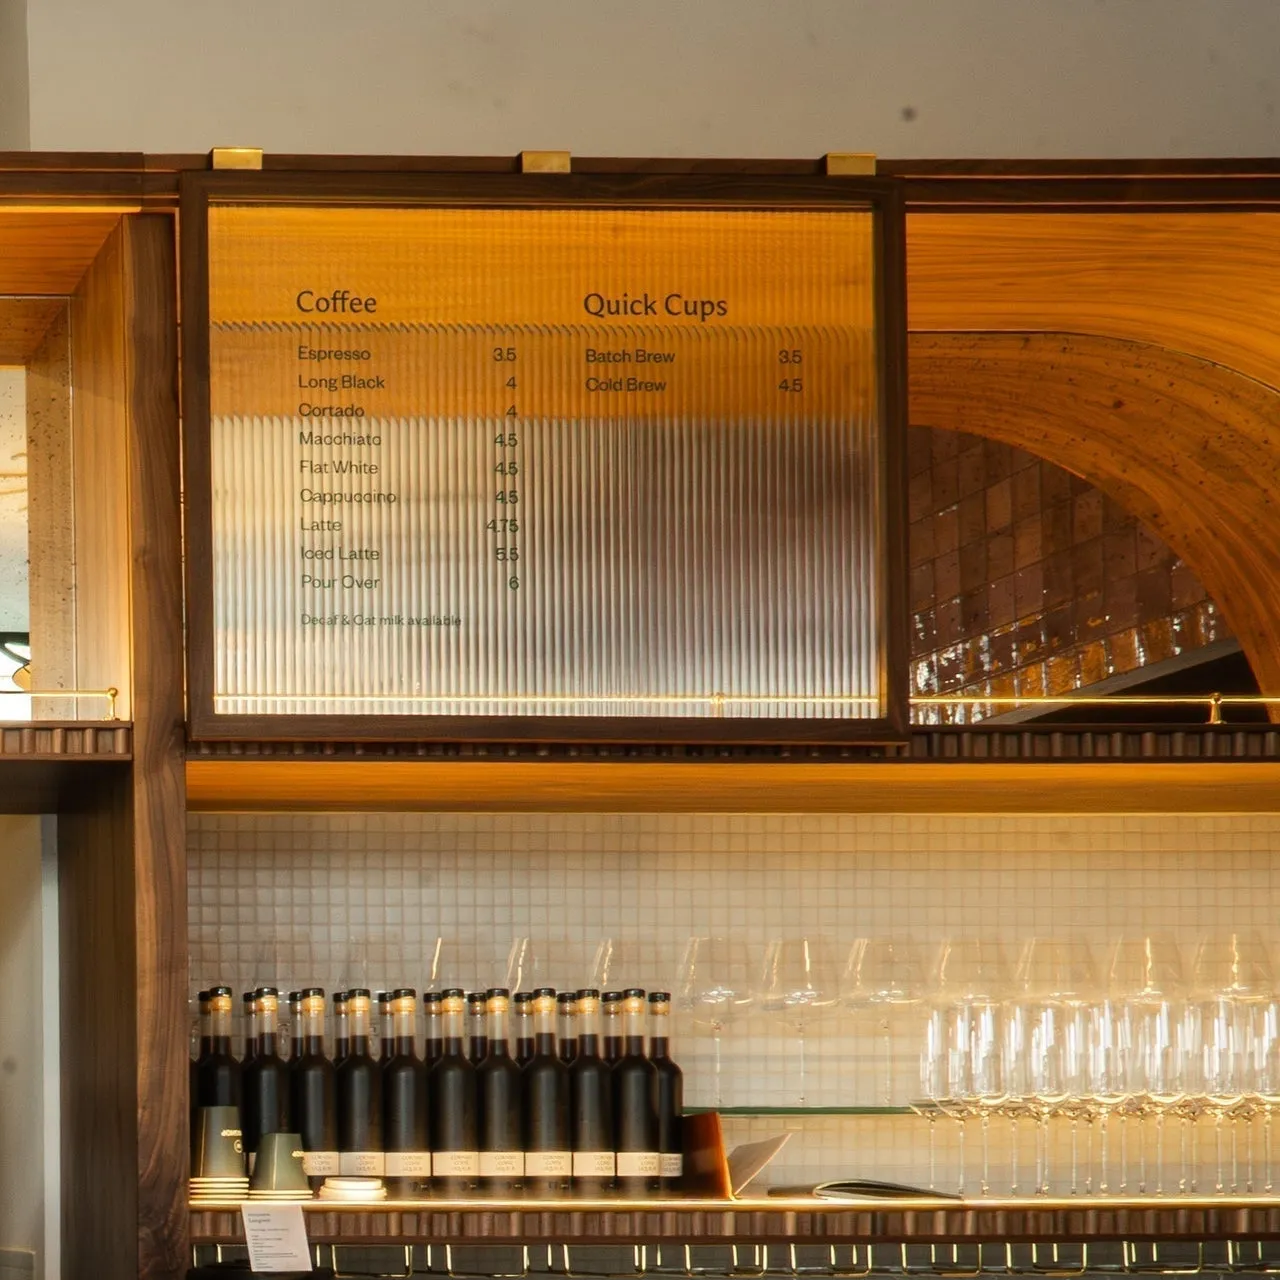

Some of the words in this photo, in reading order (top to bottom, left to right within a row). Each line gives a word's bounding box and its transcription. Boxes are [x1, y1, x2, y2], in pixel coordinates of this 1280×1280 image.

[296, 290, 377, 313] Coffee
[583, 293, 658, 318] Quick
[664, 293, 728, 322] Cups
[297, 346, 371, 363] Espresso
[492, 347, 517, 362] 3.5
[585, 349, 632, 364] Batch
[635, 349, 676, 364] Brew
[778, 350, 803, 364] 3.5
[298, 375, 338, 391] Long
[341, 375, 385, 390] Black
[505, 377, 518, 390] 4
[585, 377, 623, 392] Cold
[626, 377, 667, 392] Brew
[778, 378, 803, 393] 4.5
[298, 403, 365, 418] Cortado
[505, 405, 518, 418] 4
[299, 431, 382, 446] Macchiato
[494, 433, 518, 447] 4.5
[299, 460, 329, 474] Flat
[332, 460, 379, 474] White
[494, 461, 519, 476] 4.5
[299, 488, 397, 506] Cappuccino
[495, 490, 519, 504] 4.5
[300, 517, 342, 531] Latte
[486, 518, 520, 533] 4.75
[301, 546, 334, 560] Iced
[338, 546, 380, 560] Latte
[495, 547, 520, 561] 5.5
[301, 575, 338, 589] Pour
[341, 575, 381, 589] Over
[508, 576, 520, 590] 6
[301, 614, 339, 626] Decaf
[341, 614, 351, 626] &
[353, 614, 377, 626] Oat
[379, 614, 405, 626] milk
[407, 614, 462, 627] available
